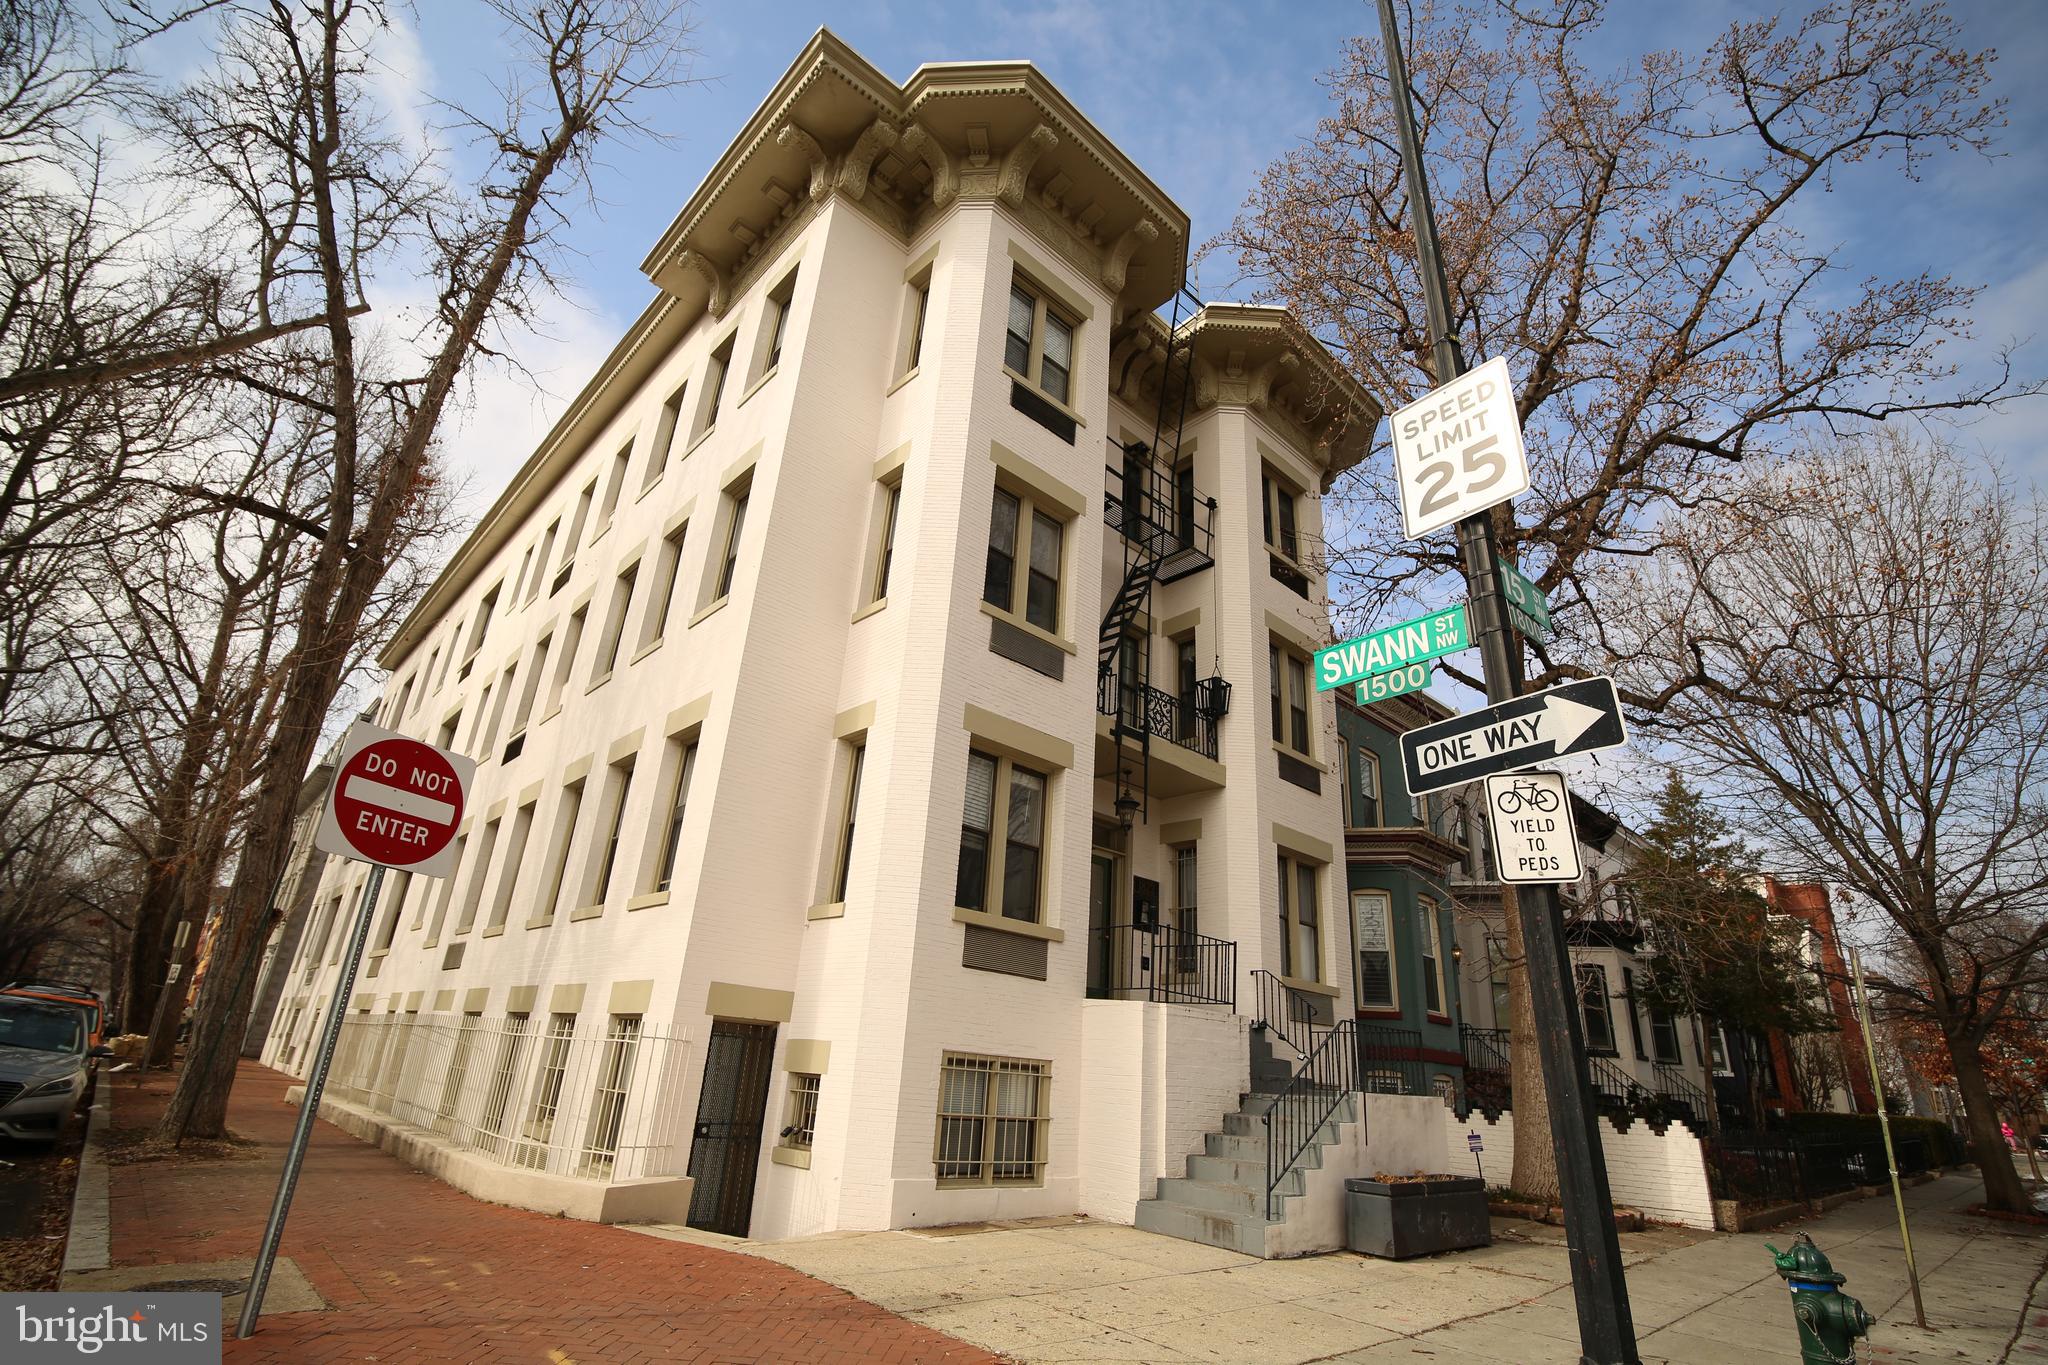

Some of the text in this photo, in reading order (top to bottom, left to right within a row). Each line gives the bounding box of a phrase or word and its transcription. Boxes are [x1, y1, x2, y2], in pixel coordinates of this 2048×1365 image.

[1403, 381, 1496, 440] SPEED
[1416, 409, 1489, 461] LIMIT
[1414, 435, 1506, 517] 25
[1500, 565, 1525, 604] 15
[1436, 629, 1459, 648] NW
[1510, 606, 1543, 641] 1800
[1322, 614, 1457, 683] SWANN ST
[1358, 664, 1426, 697] 1500
[1423, 714, 1543, 770] ONE WAY
[365, 752, 453, 795] DO NOT
[356, 810, 429, 846] ENTER
[1510, 818, 1556, 834] YIELD
[1526, 838, 1545, 852] TO
[1519, 857, 1560, 872] PEDS
